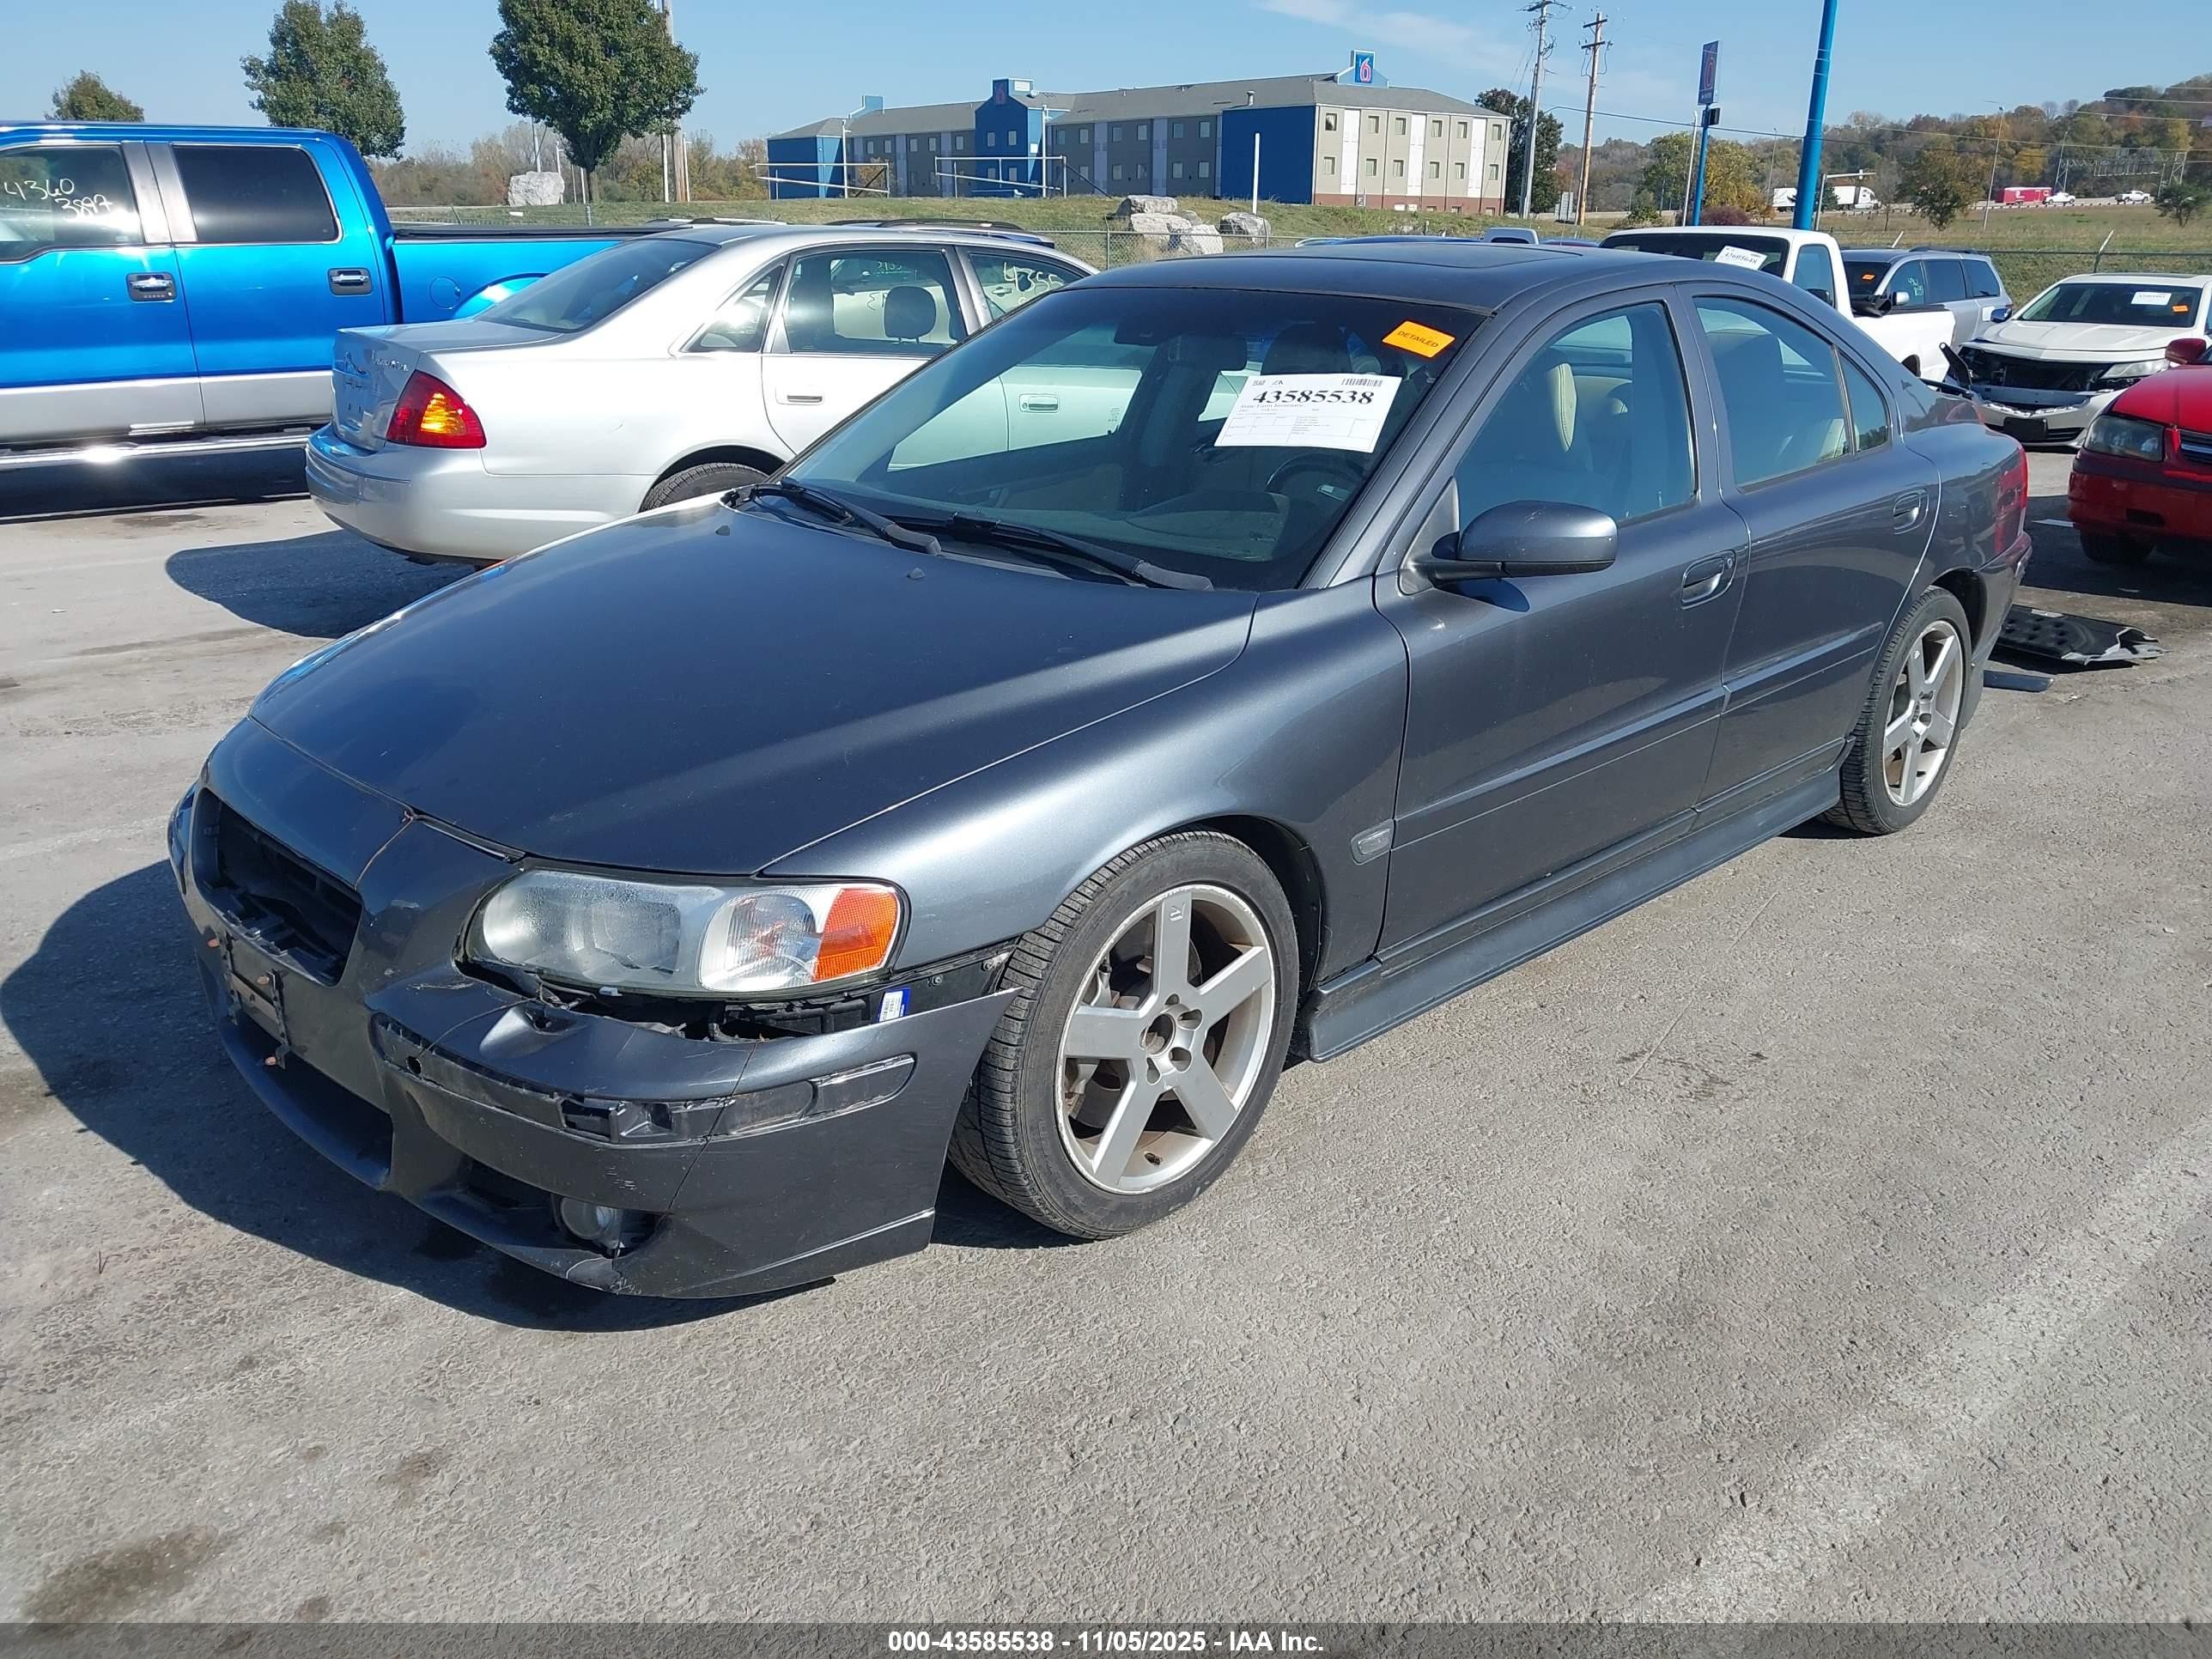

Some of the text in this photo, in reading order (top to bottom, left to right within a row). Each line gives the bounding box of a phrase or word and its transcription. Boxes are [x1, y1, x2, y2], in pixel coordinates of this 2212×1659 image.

[1360, 58, 1371, 82] 6
[3, 178, 75, 201] 4360
[1397, 331, 1439, 348] DETAILED
[1253, 389, 1375, 405] 43585538
